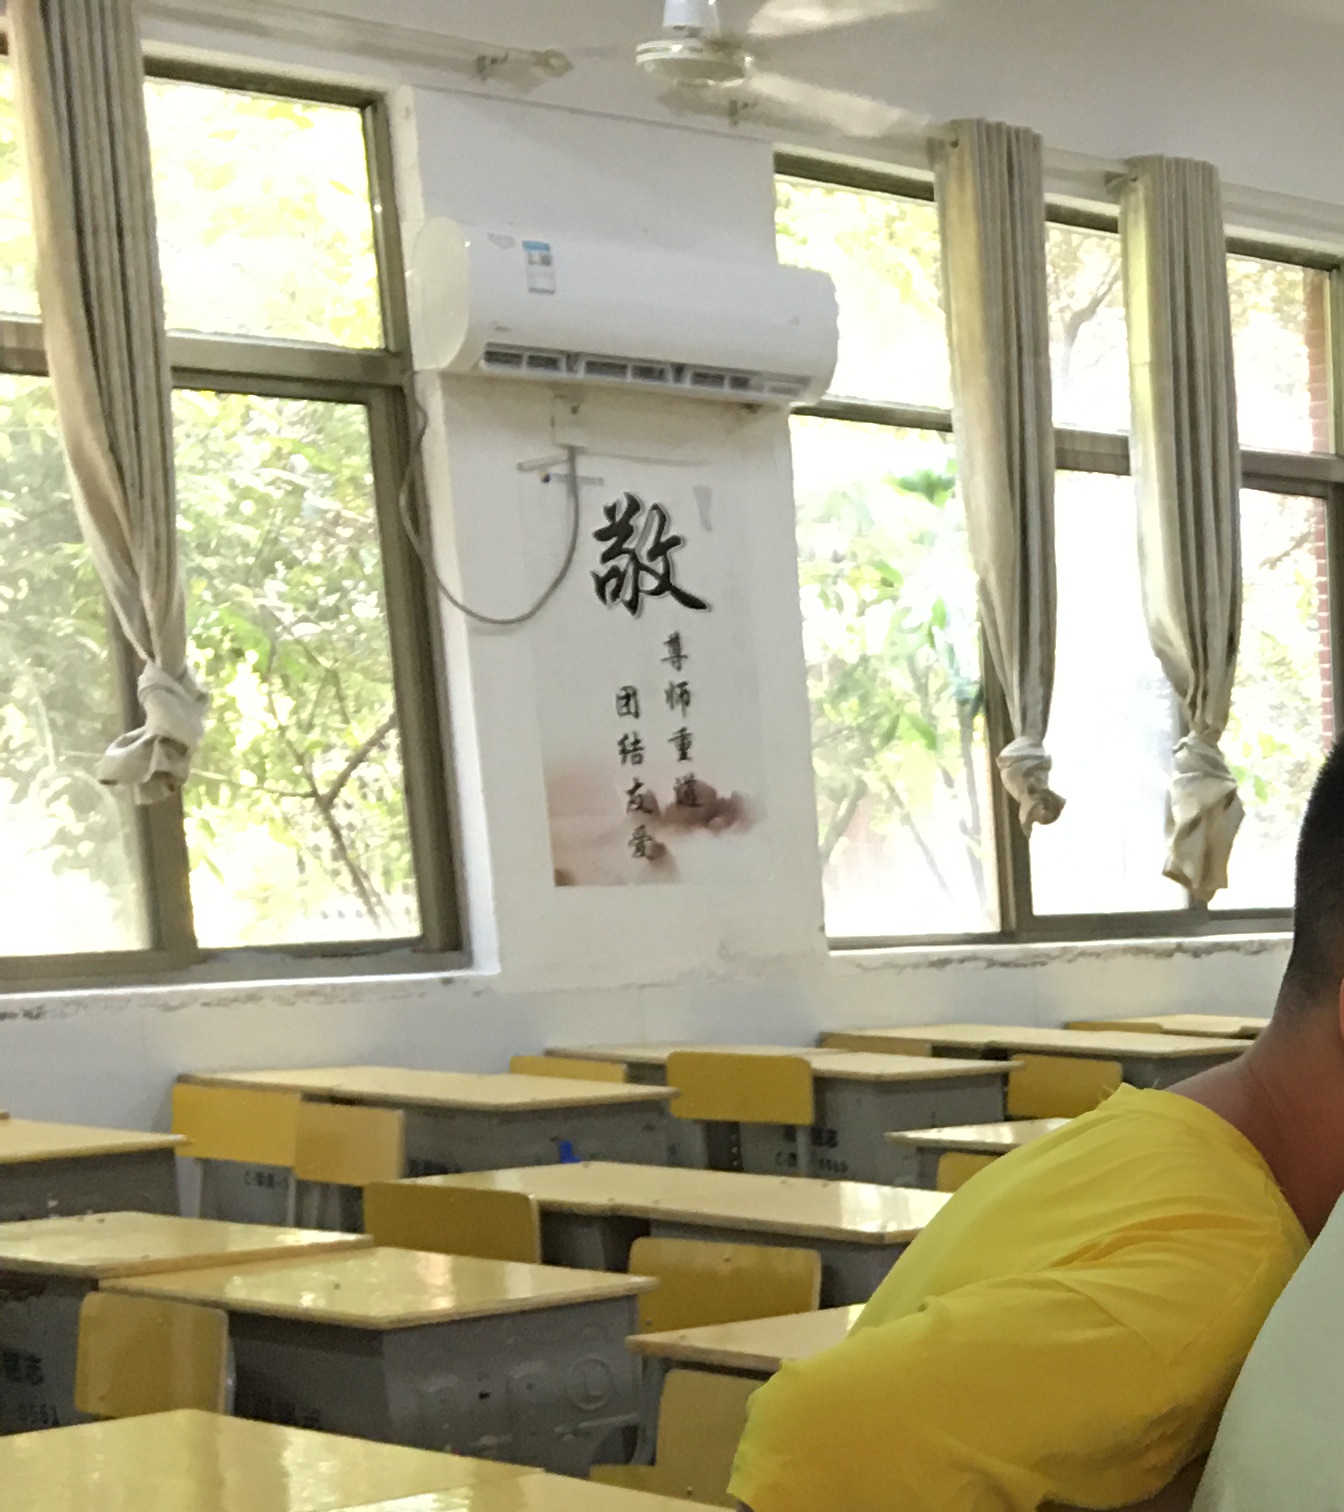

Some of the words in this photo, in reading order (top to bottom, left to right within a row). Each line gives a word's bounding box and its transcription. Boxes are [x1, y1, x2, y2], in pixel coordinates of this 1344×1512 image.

[590, 492, 710, 618] 敬
[615, 685, 655, 861] 团结友爱
[660, 631, 703, 808] 尊师重道
